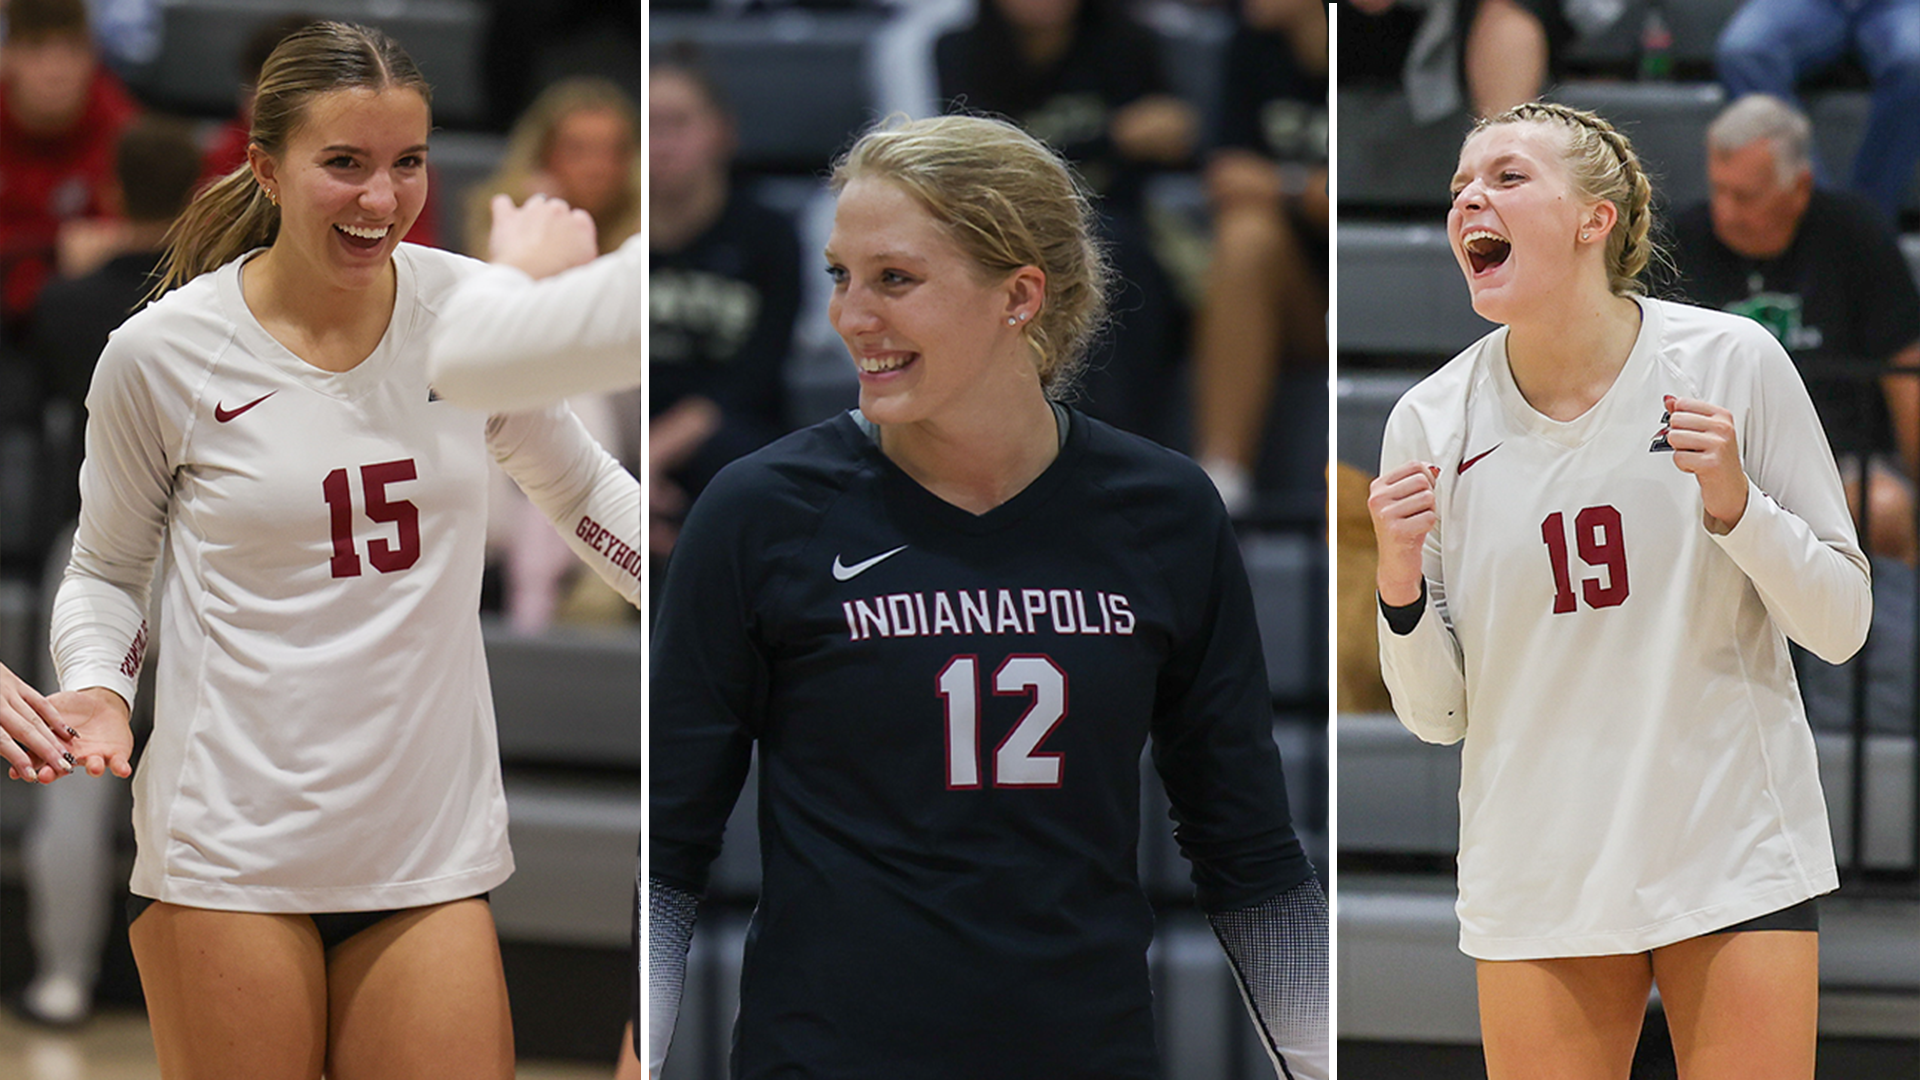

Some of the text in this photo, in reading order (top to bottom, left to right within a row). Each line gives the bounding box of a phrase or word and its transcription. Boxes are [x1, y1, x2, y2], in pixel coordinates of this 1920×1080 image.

[322, 457, 421, 578] 15
[575, 515, 641, 582] GREYHOU
[1540, 504, 1630, 615] 19
[842, 588, 1136, 640] INDIANAPOLIS
[935, 653, 1068, 790] 12
